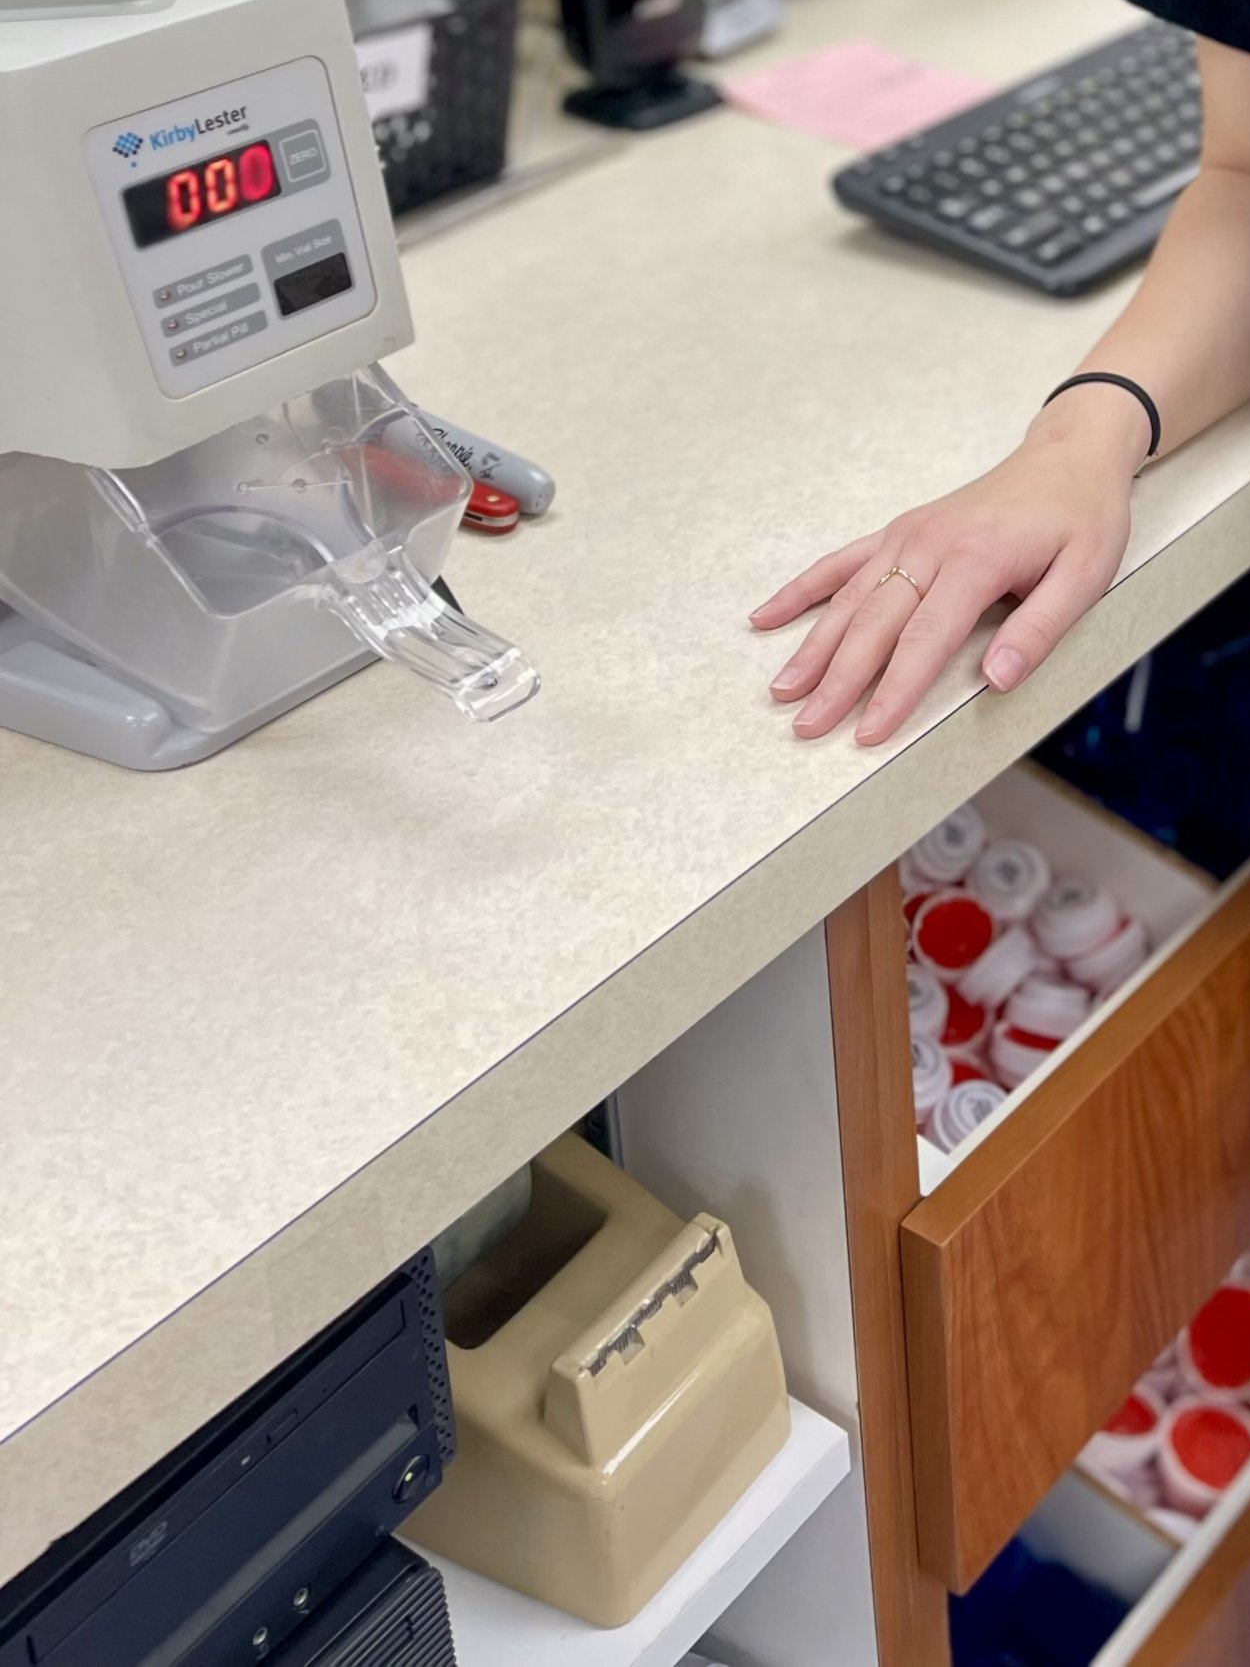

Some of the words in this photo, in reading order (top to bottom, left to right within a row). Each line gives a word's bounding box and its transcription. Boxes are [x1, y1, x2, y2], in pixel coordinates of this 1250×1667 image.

[150, 105, 247, 151] KirbyLester
[289, 146, 318, 166] ZERO
[167, 143, 274, 230] 000
[177, 278, 205, 296] Pour
[207, 261, 244, 284] Slower
[184, 299, 227, 326] Special
[192, 331, 229, 353] Partial
[231, 323, 249, 338] Pill
